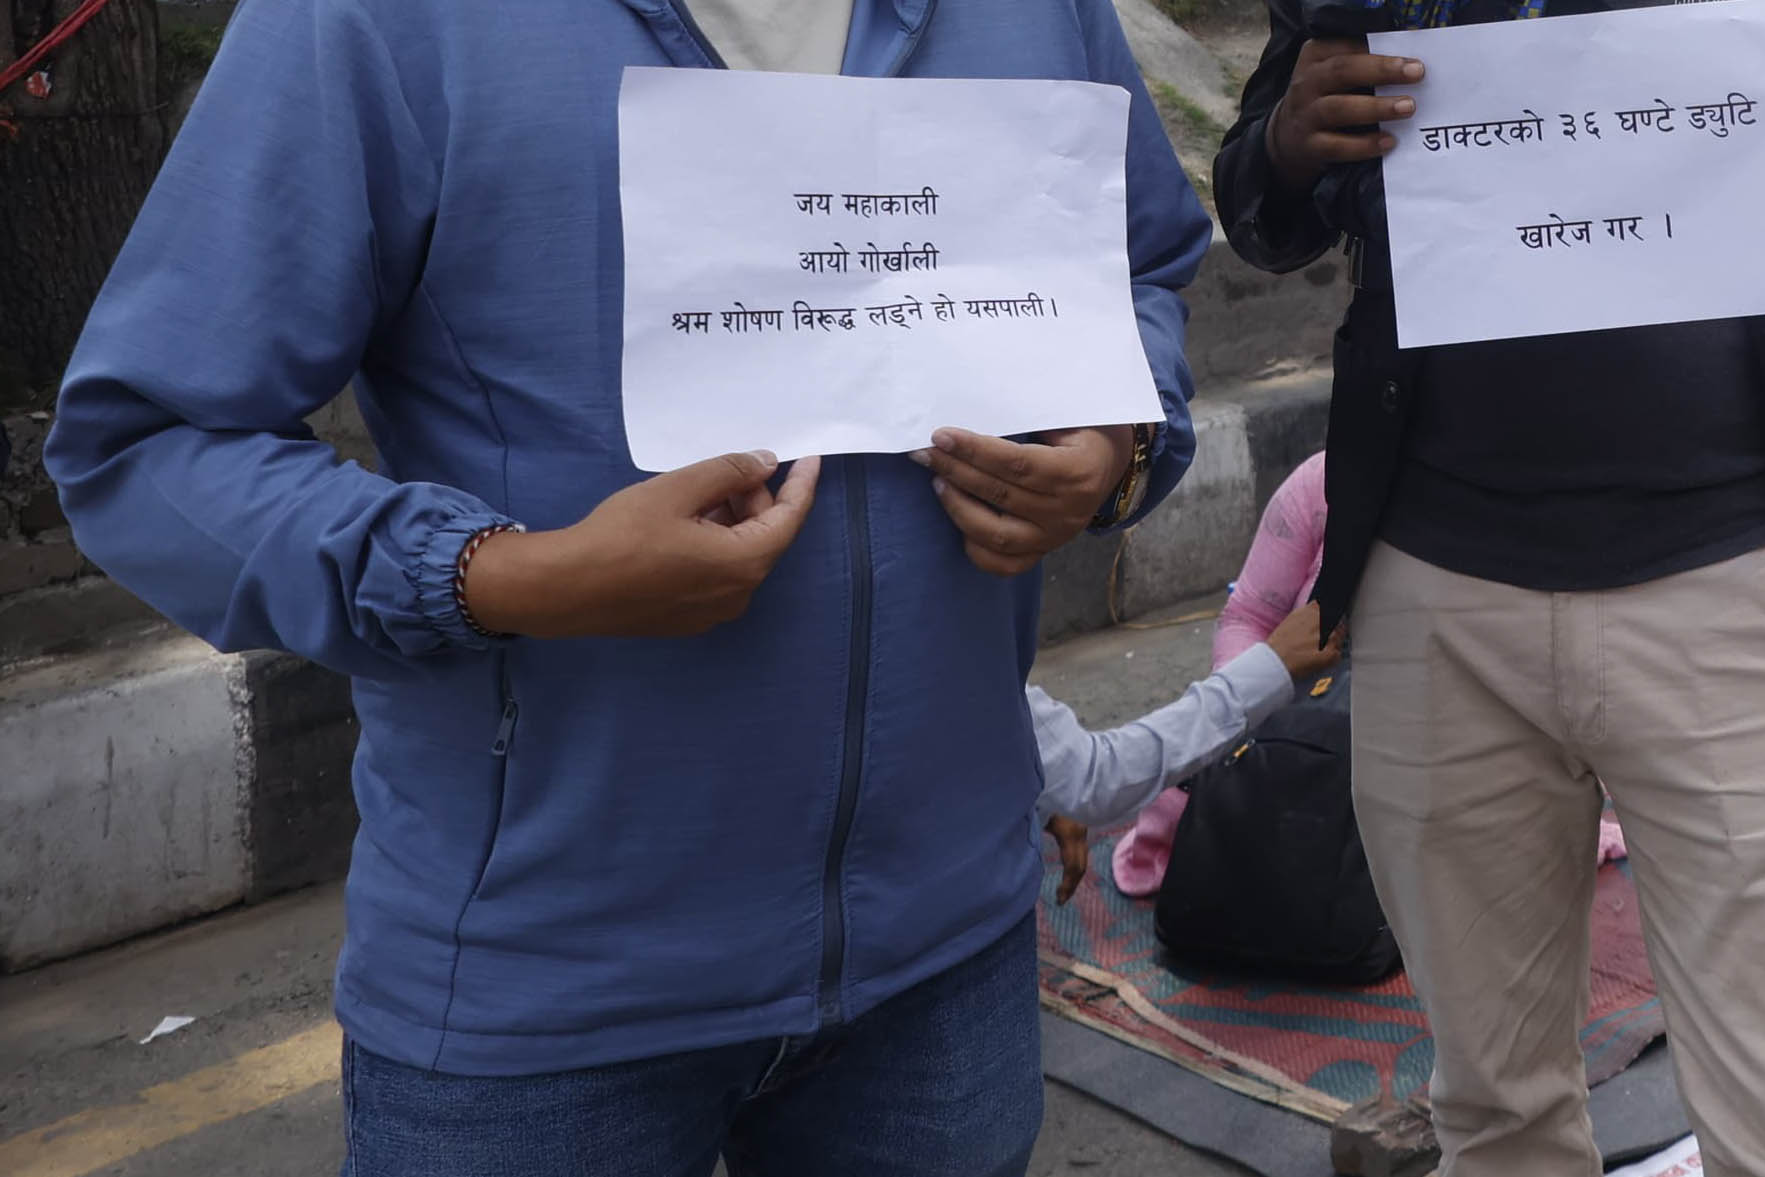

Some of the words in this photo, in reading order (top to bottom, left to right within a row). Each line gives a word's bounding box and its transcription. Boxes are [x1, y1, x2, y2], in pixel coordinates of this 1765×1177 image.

[1419, 108, 1545, 152] डाक्टरको
[1559, 111, 1602, 142] ३६
[1614, 98, 1676, 135] घण्टे
[1684, 92, 1758, 138] ड्युटि
[793, 194, 834, 216] जय
[841, 186, 940, 219] महाकाली
[1515, 212, 1594, 249] खारेज
[1602, 216, 1644, 242] गर
[799, 242, 851, 274] आयो
[858, 242, 941, 273] गोर्खाली
[672, 312, 713, 335] श्रम
[720, 302, 785, 334] शोषण
[864, 295, 924, 330] लड्ने
[930, 293, 956, 322] हो
